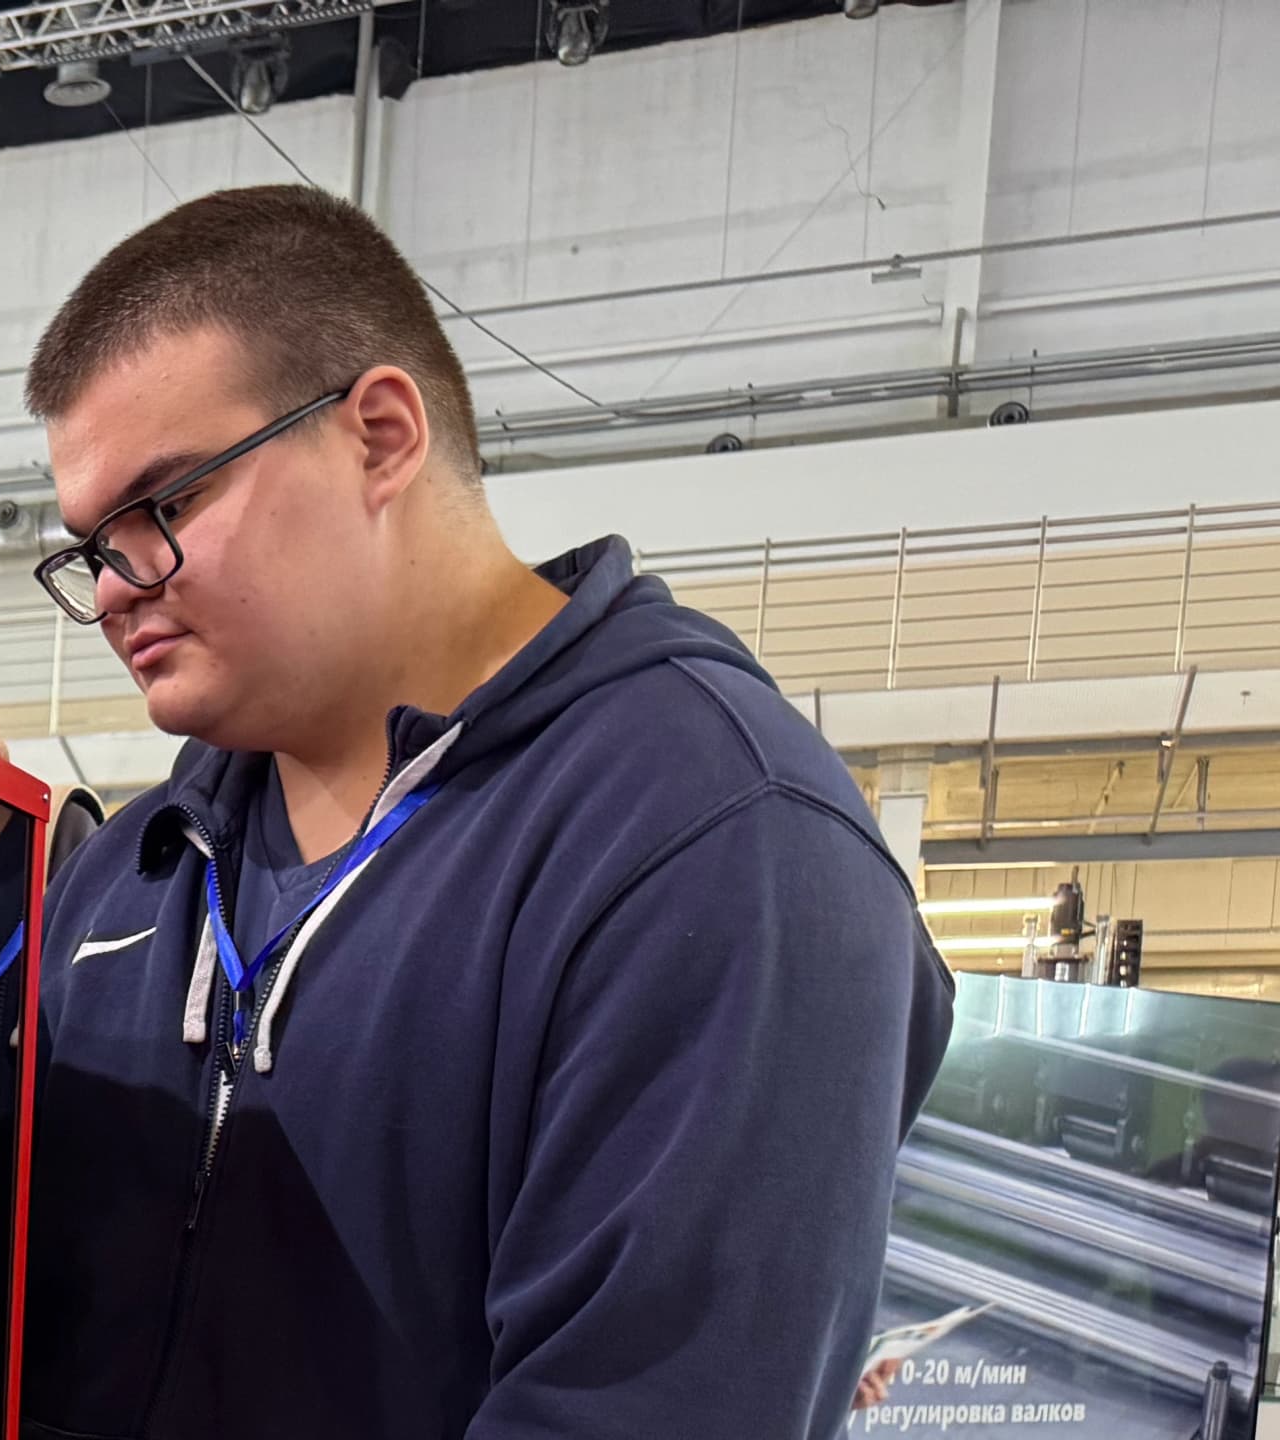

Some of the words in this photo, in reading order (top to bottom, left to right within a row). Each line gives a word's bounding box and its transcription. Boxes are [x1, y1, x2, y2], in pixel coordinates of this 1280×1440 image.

[954, 1359, 1027, 1389] м/мин
[864, 1402, 1006, 1433] регулировка
[1011, 1402, 1087, 1424] валков
